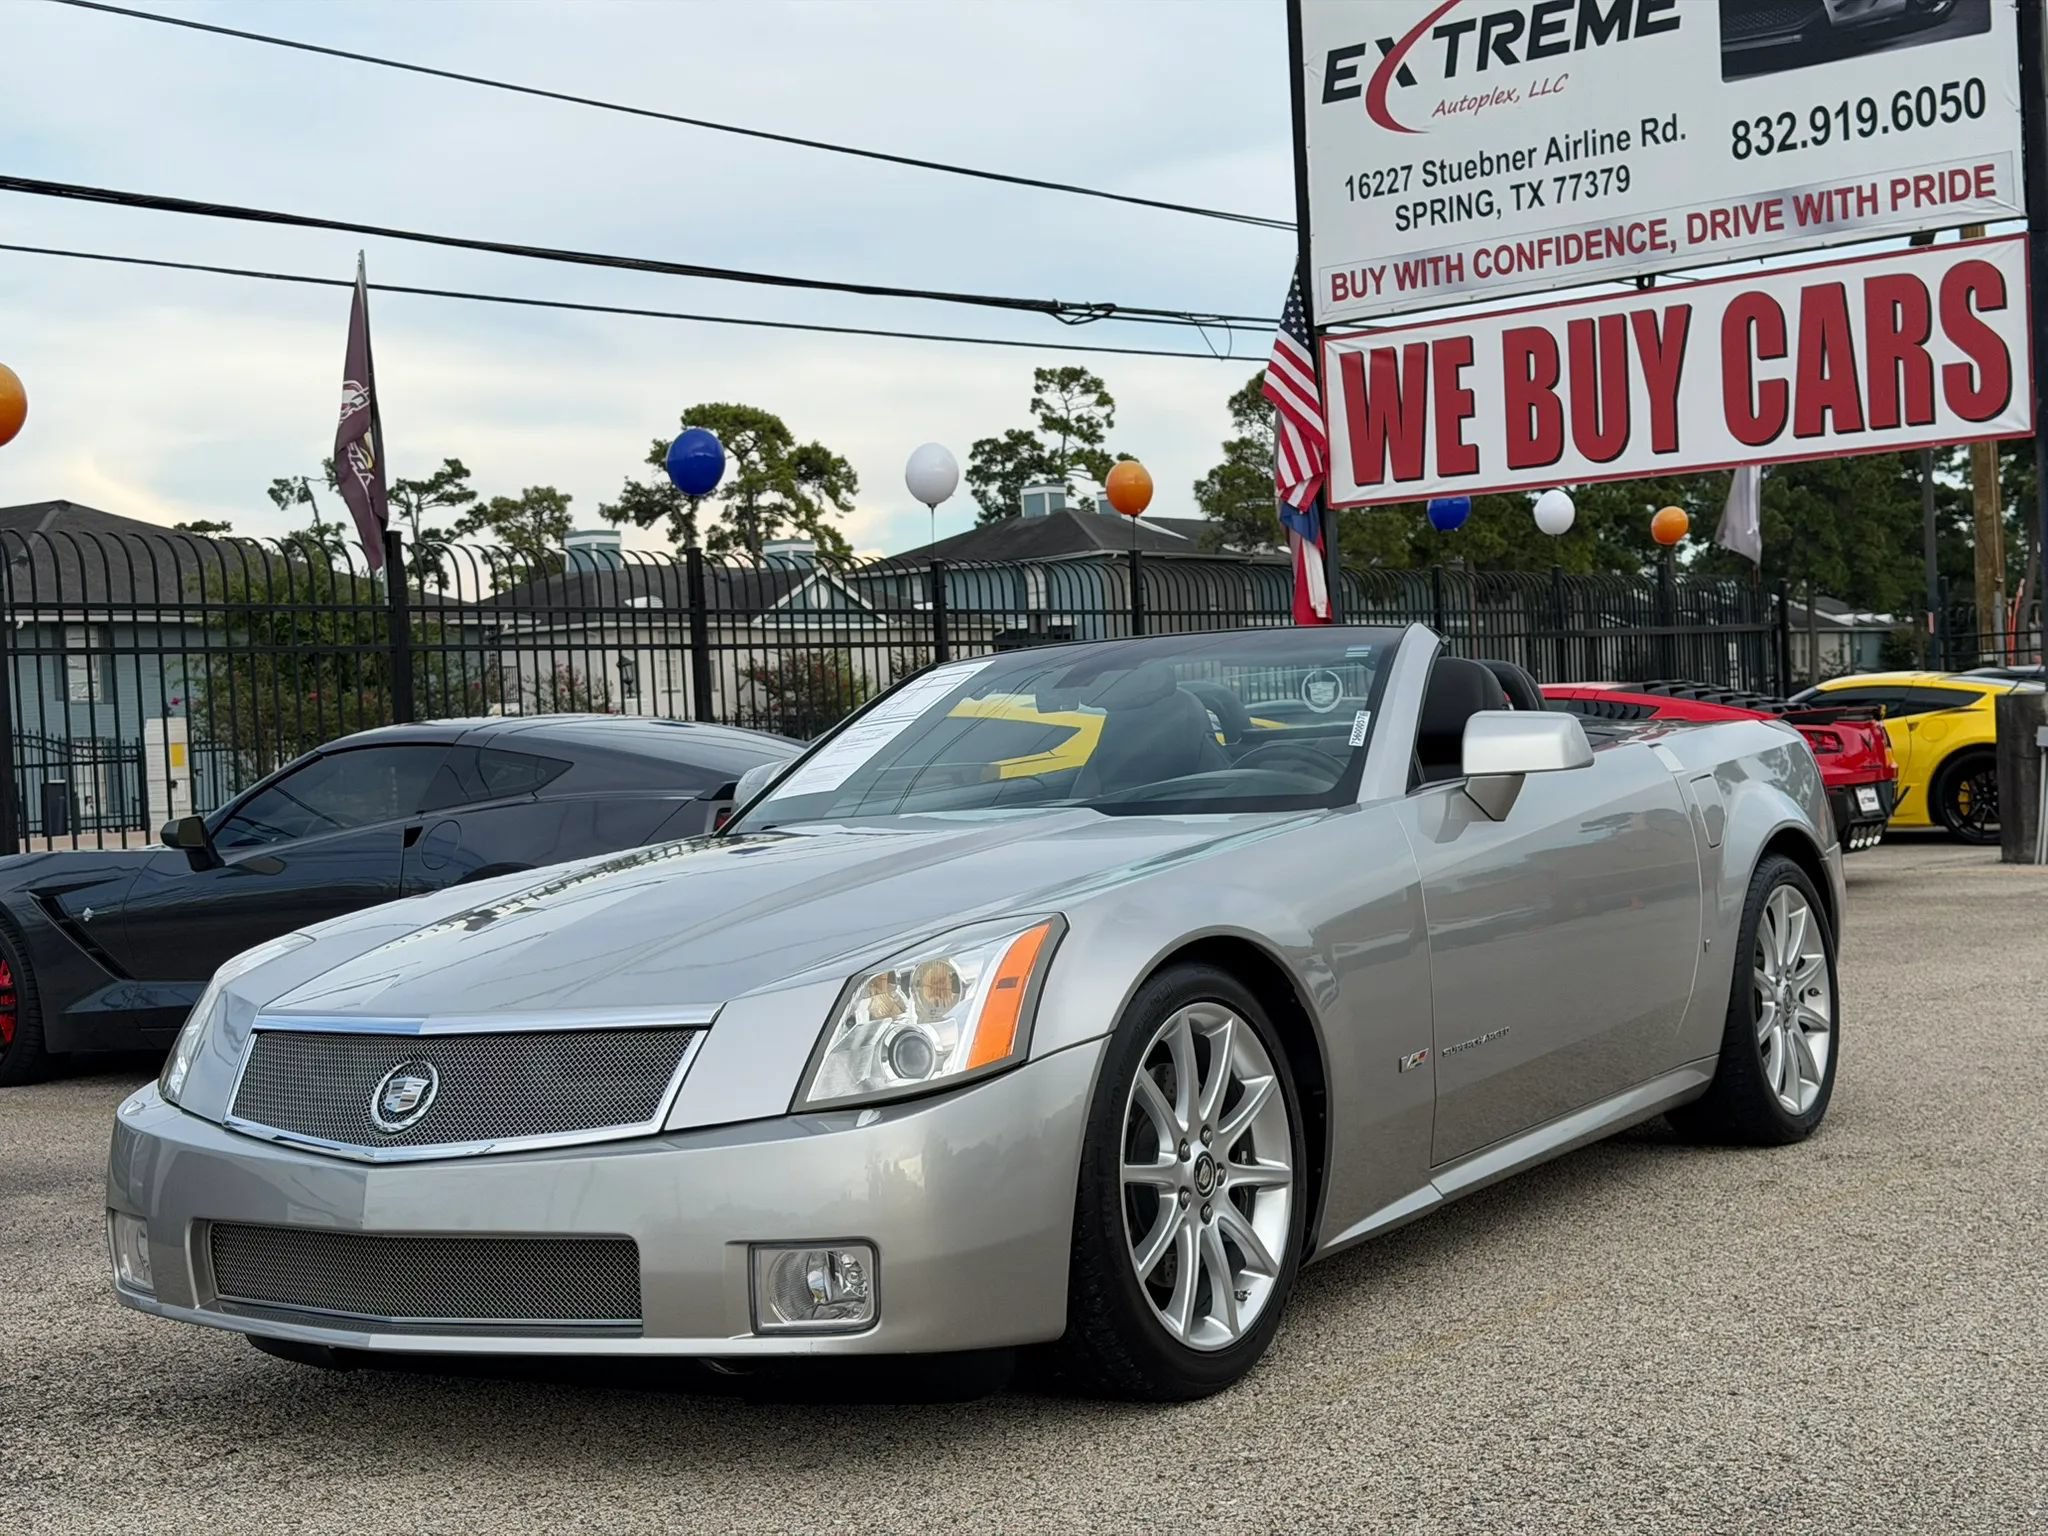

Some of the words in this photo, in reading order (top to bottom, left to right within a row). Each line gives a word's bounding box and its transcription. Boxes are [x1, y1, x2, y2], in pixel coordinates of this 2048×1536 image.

[1321, 0, 1682, 105] EXTREME
[1431, 84, 1521, 118] Autoplex,
[1528, 72, 1569, 99] LLC
[1344, 164, 1413, 202] 16227
[1422, 147, 1538, 188] Stuebner
[1544, 128, 1631, 166] Airline
[1640, 112, 1686, 148] Rd.
[1731, 77, 1986, 161] 832.919.6050
[1331, 265, 1387, 302] BUY
[1393, 255, 1464, 291] WITH
[1473, 220, 1678, 278] CONFIDENCE,
[1687, 199, 1783, 245] DRIVE
[1793, 182, 1878, 225] WITH
[1891, 164, 1995, 210] PRIDE
[1395, 189, 1502, 232] SPRING,
[1509, 179, 1545, 211] TX
[1552, 164, 1631, 204] 77379
[1338, 336, 1479, 487] WE
[1502, 304, 1691, 470] BUY
[1721, 260, 2012, 446] CARS
